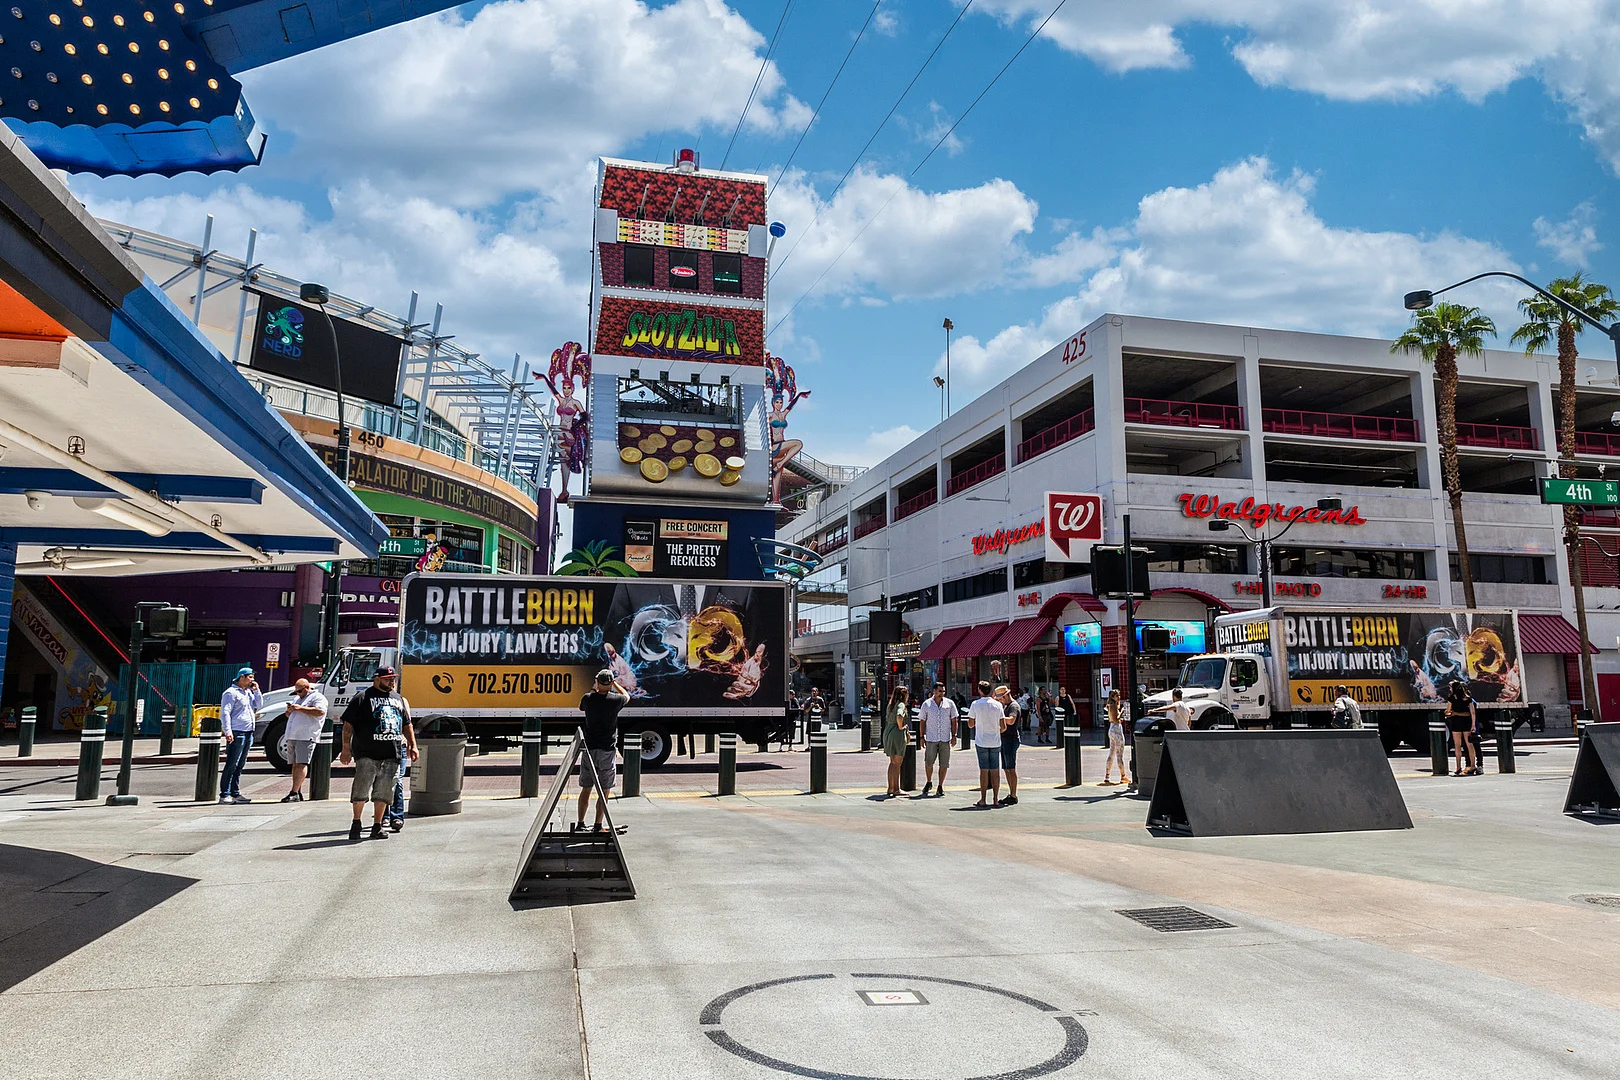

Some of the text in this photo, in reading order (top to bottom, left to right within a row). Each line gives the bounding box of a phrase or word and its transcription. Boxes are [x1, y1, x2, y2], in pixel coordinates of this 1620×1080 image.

[621, 308, 741, 356] SLOTZILLA
[263, 337, 302, 358] NERD
[1062, 331, 1087, 365] 425
[358, 431, 384, 449] 450
[324, 451, 408, 491] ECALATOR
[411, 472, 428, 494] UP
[431, 478, 444, 500] TO
[447, 483, 465, 505] THE
[466, 489, 481, 511] 2ND
[1566, 483, 1592, 500] 4th
[1606, 483, 1613, 491] St
[1606, 494, 1618, 502] 100
[1054, 501, 1095, 531] W
[1178, 493, 1367, 529] Walgreens
[666, 521, 722, 533] FREE CONCERT
[379, 540, 401, 552] 4th
[666, 543, 721, 556] THE PRETTY
[670, 555, 716, 568] RECKLESS
[1275, 582, 1322, 597] PHOTO
[1383, 584, 1427, 599] 24-HR
[424, 585, 594, 625] BATTLEBORN
[1219, 621, 1269, 645] BATTLEBORN
[1285, 616, 1400, 647] BATTLEBORN
[440, 631, 578, 655] INJURY LAWYERS
[1298, 651, 1393, 671] INJURY LAWYERS
[467, 672, 573, 695] 702.570.9000
[1320, 685, 1393, 703] 7070.9000
